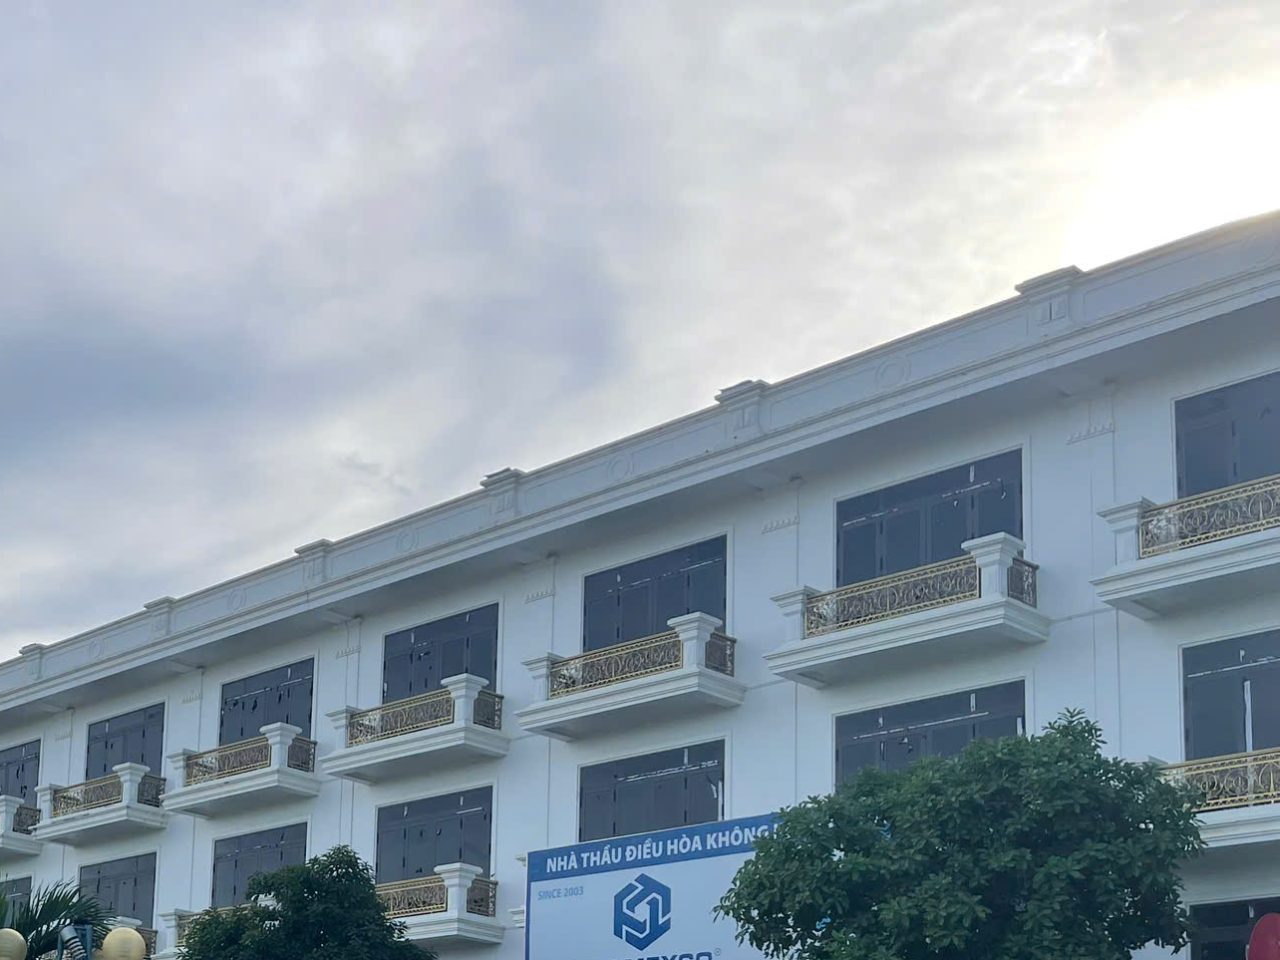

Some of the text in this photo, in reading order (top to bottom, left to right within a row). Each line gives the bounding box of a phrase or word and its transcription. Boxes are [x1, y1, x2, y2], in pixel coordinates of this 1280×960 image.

[546, 851, 578, 873] NHÀ
[666, 836, 702, 857] HÒA
[537, 886, 584, 900] SINCE 2003
